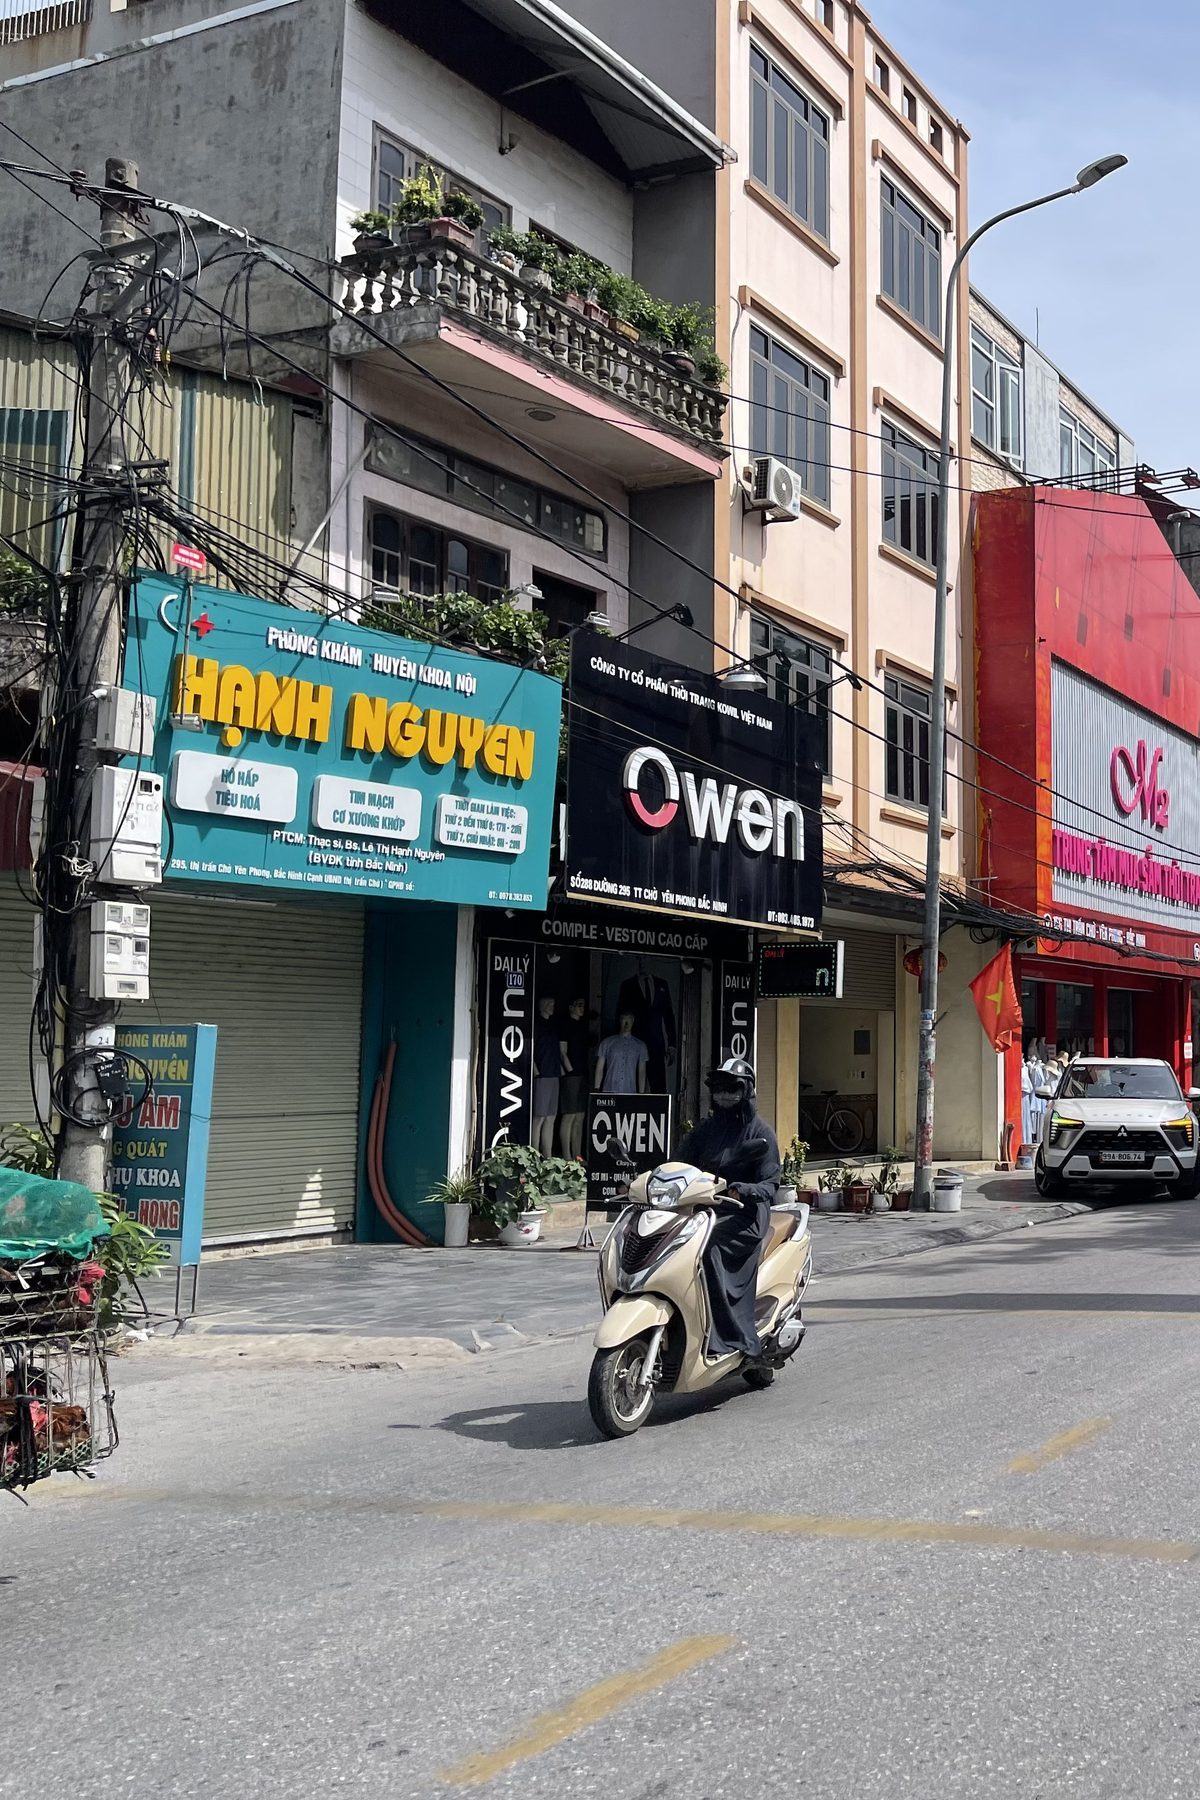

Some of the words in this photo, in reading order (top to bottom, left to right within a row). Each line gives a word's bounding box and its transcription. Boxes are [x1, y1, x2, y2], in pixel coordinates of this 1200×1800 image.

[268, 627, 318, 656] PHÒNG
[321, 641, 362, 666] KHÁM
[419, 664, 452, 688] KHOA
[456, 673, 477, 697] NỘI
[175, 654, 333, 748] HẠNH
[590, 657, 615, 676] CÔNG
[618, 667, 630, 681] TY
[631, 669, 644, 685] CỔ
[646, 677, 668, 694] PHẦN
[671, 685, 688, 701] THỜI
[690, 692, 715, 710] TRANG
[717, 702, 739, 719] KOWIL
[741, 710, 755, 725] VIỆT
[757, 718, 772, 730] NAM
[221, 767, 235, 784] HÔ
[237, 768, 259, 787] HẤP
[216, 790, 238, 807] TIÊU
[240, 793, 261, 811] HOÁ
[349, 790, 365, 805] TIM
[368, 792, 394, 810] MẠCH
[623, 746, 805, 861] Owen
[333, 809, 346, 823] CƠ
[348, 811, 379, 828] XƯƠNG
[381, 815, 405, 831] KHỚP
[308, 835, 331, 847] Thạc
[362, 842, 373, 851] Lê
[377, 843, 389, 856] Thị
[391, 845, 412, 858] Hạnh
[365, 857, 382, 869] Bắc
[385, 861, 408, 874] Ninh)
[1053, 829, 1091, 876] TRUNG
[1092, 835, 1119, 883] TÂM
[1119, 849, 1139, 889] MUA
[1138, 844, 1162, 894] SẮM
[1162, 859, 1183, 901] THỜI
[594, 877, 618, 895] ĐƯỜNG
[619, 884, 630, 896] 295
[634, 887, 642, 898] TT
[644, 887, 658, 900] CHỜ
[662, 890, 674, 904] YÊN
[676, 894, 696, 908] PHONG
[698, 894, 710, 909] BẮC
[713, 901, 727, 912] NINH
[542, 920, 597, 940] COMPLE
[606, 926, 655, 945] VESTON
[658, 935, 682, 948] CAO
[509, 974, 523, 986] 170
[116, 1031, 149, 1048] HÒNG
[153, 1032, 187, 1047] KHÁM
[592, 1111, 665, 1153] OWEN
[127, 1138, 168, 1158] QUÁT
[136, 1168, 180, 1188] KHOA
[138, 1200, 180, 1233] HỌNG
